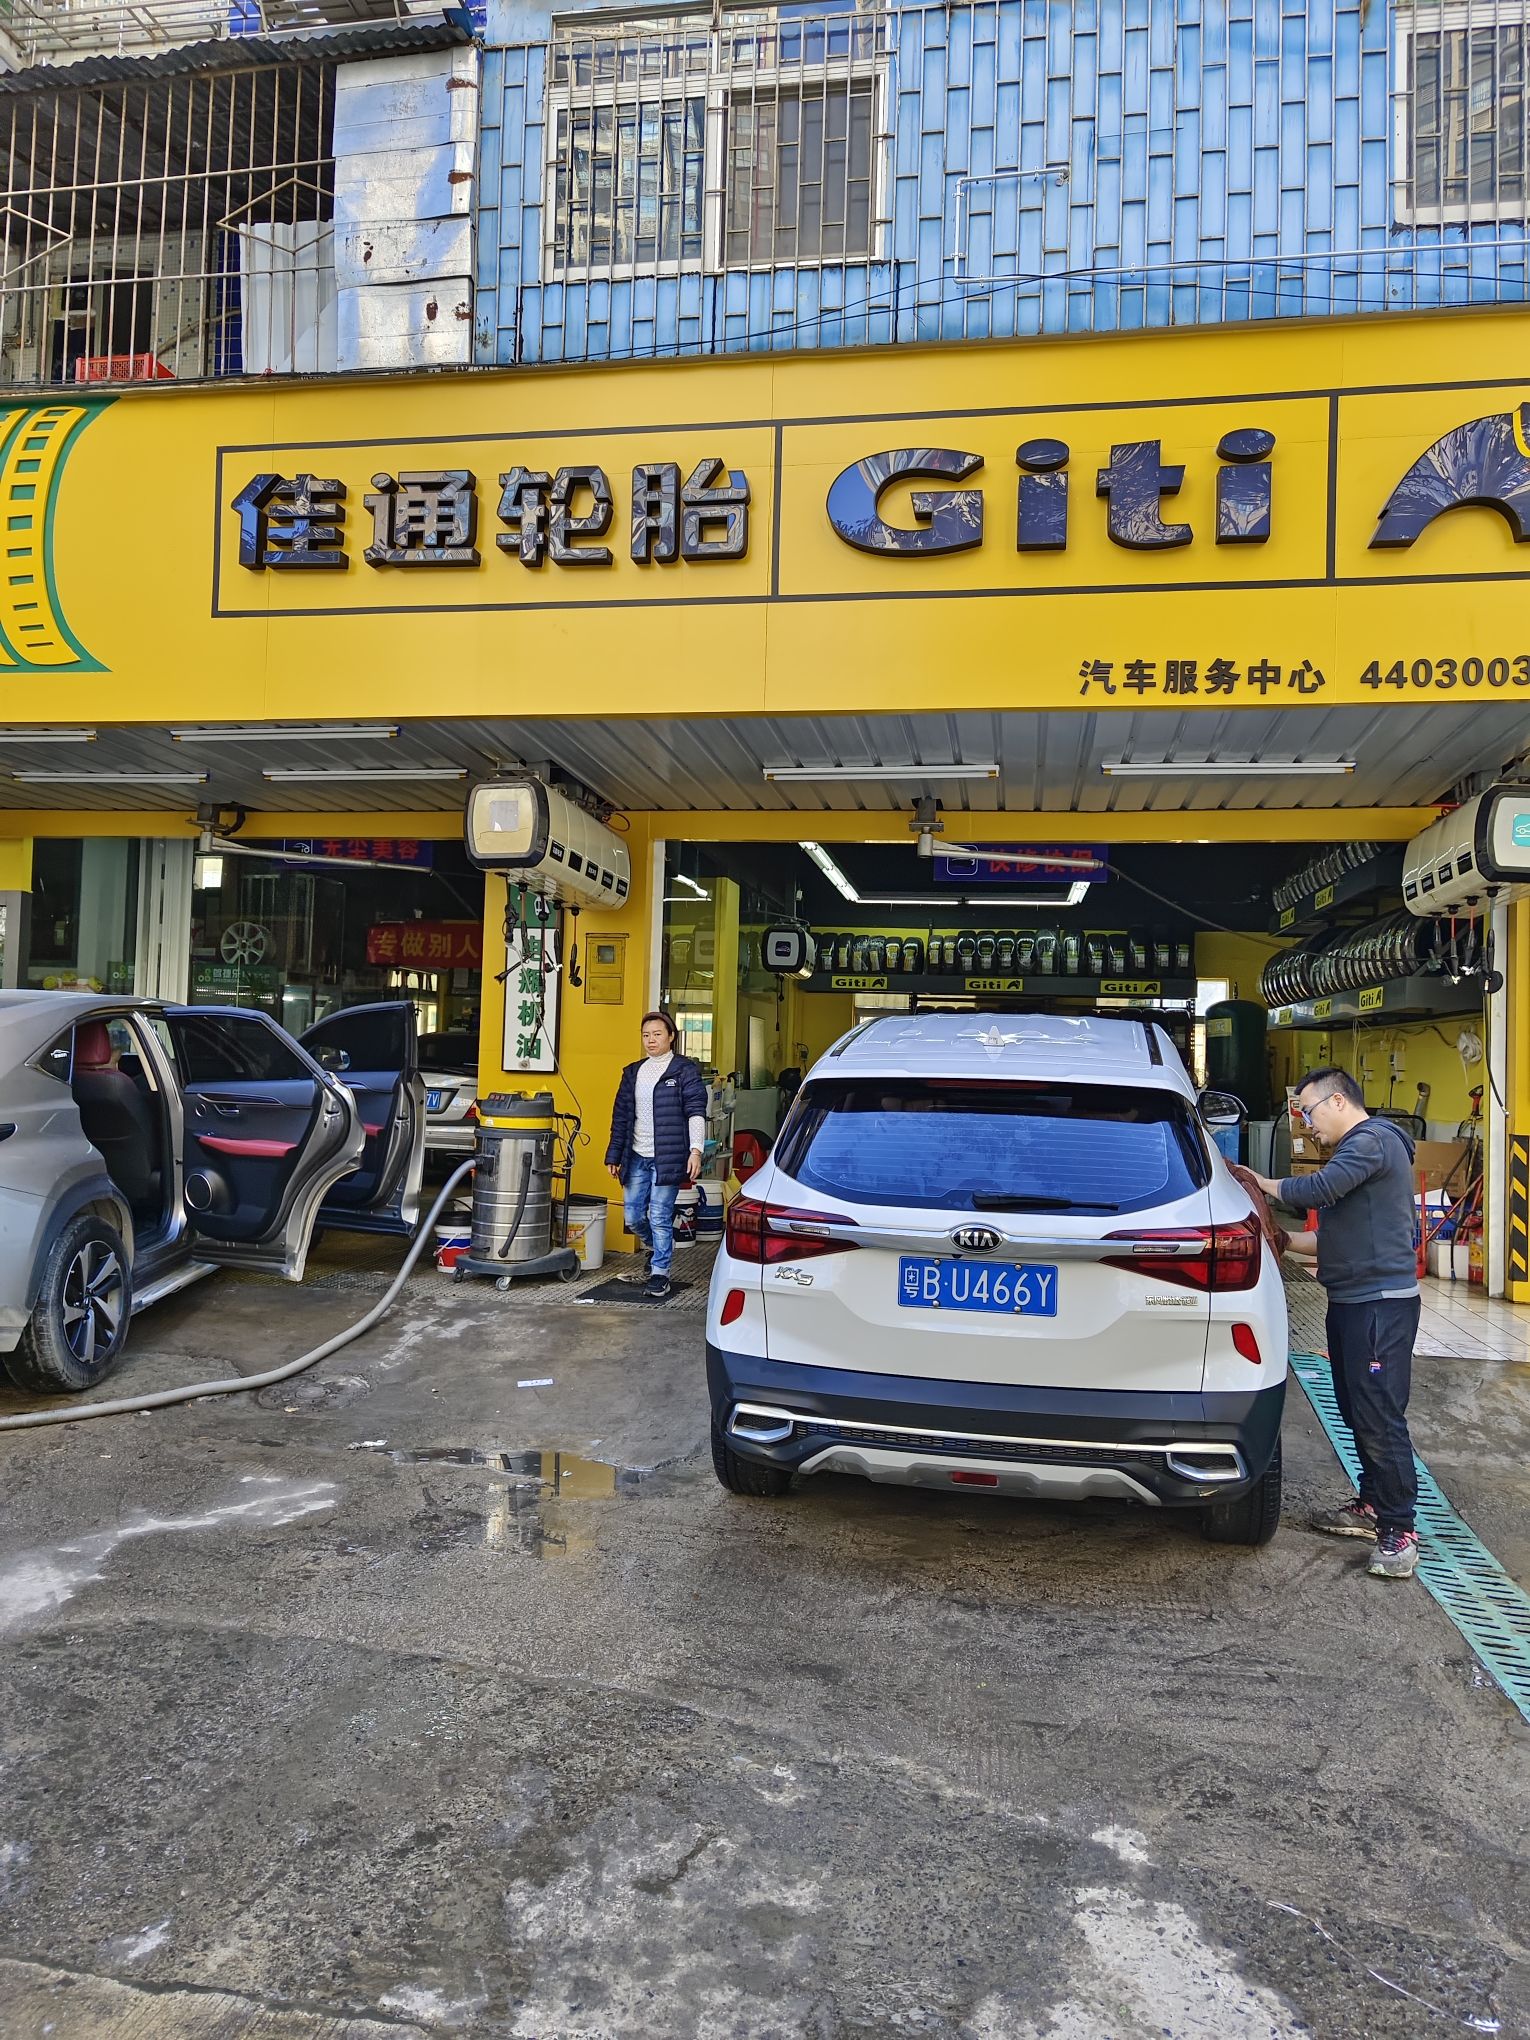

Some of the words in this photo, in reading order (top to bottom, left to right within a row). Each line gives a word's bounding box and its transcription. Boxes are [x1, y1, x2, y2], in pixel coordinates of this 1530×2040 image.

[825, 428, 1276, 558] Giti
[231, 457, 751, 570] 佳通轮胎
[1078, 657, 1326, 695] 汽车服务中心
[373, 928, 480, 959] 专做别人
[834, 978, 867, 988] Giti
[969, 980, 1002, 991] Giti
[1103, 983, 1139, 993] Giti
[1360, 994, 1375, 1007] Giti
[959, 1231, 994, 1247] KIA
